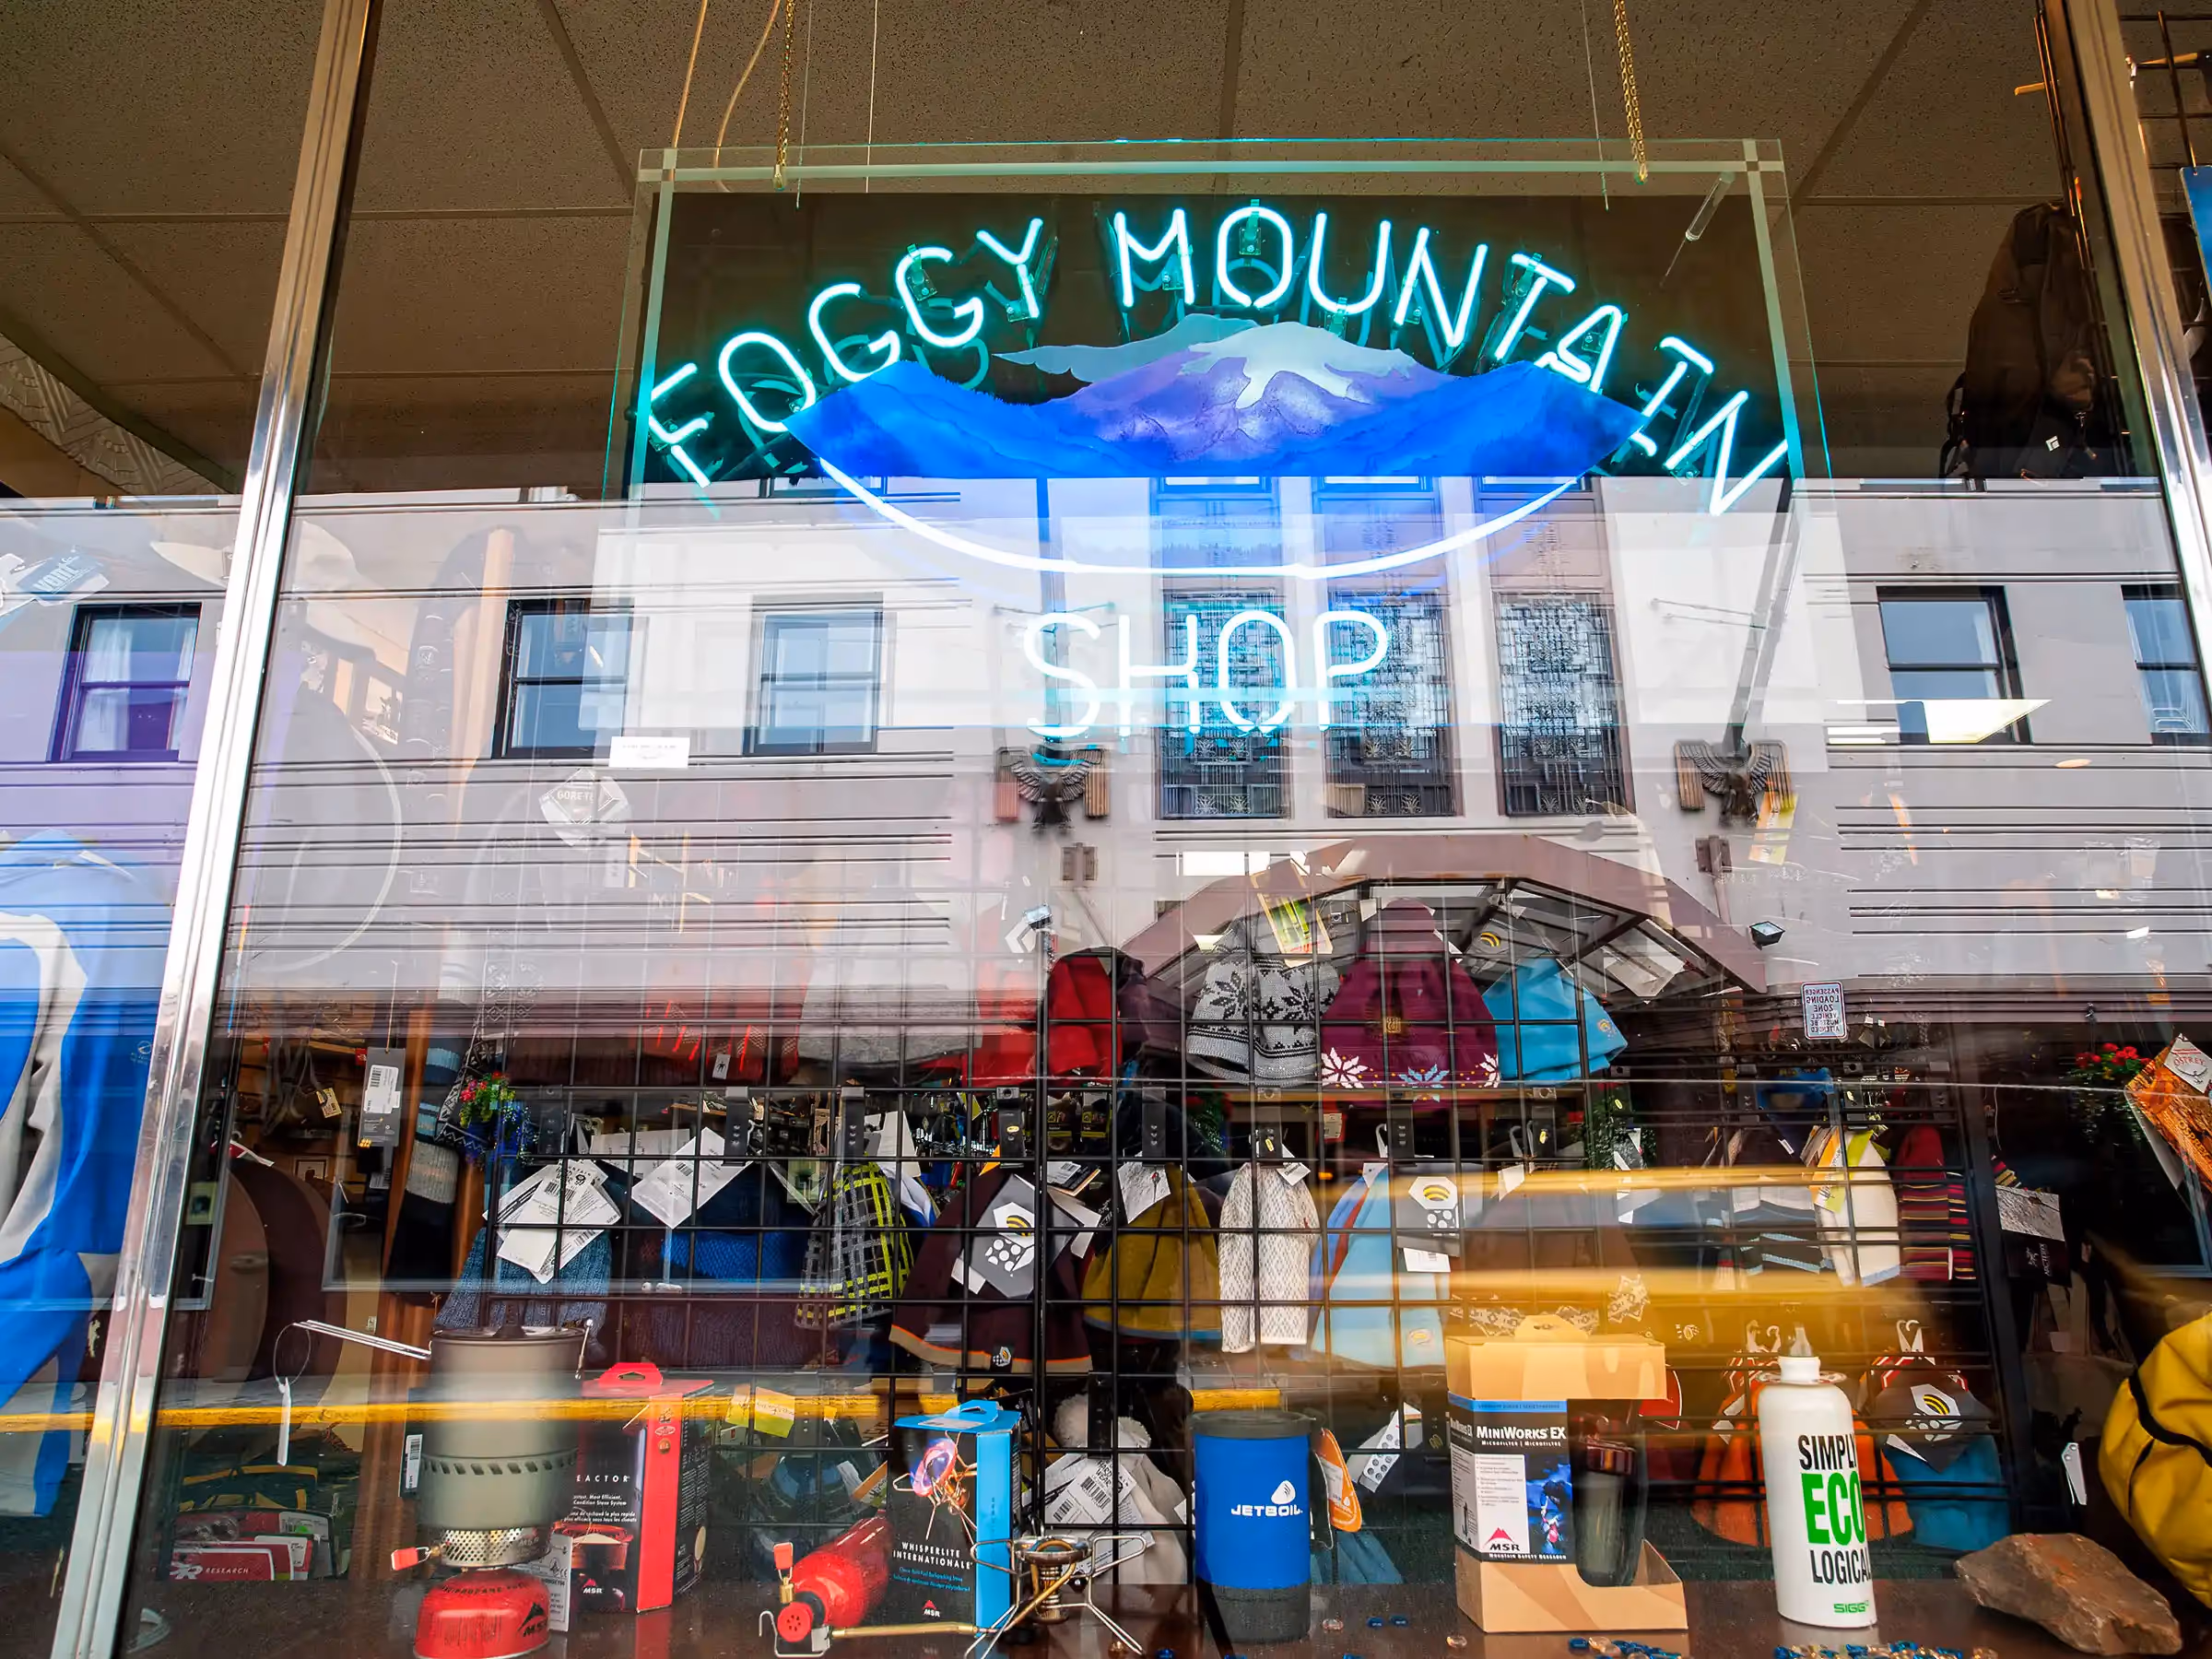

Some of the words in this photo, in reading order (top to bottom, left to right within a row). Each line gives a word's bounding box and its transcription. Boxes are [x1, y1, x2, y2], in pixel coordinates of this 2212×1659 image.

[647, 217, 1043, 488] FOGGY
[1112, 204, 1788, 517] MOUNTAIN
[1023, 609, 1390, 738] SHOP
[2173, 1055, 2206, 1066] OSPREY
[1550, 1426, 1567, 1440] EX
[576, 1475, 629, 1483] EACTOR
[1230, 1503, 1300, 1517] JETBOIL
[1800, 1470, 1865, 1547] ECO
[901, 1541, 960, 1559] WHISPERLITE
[1489, 1544, 1521, 1552] MSR
[892, 1549, 971, 1570] INTERNATIONALE
[205, 1567, 250, 1575] RESEARCH
[924, 1608, 940, 1618] MSR
[1833, 1603, 1866, 1614] SIGG
